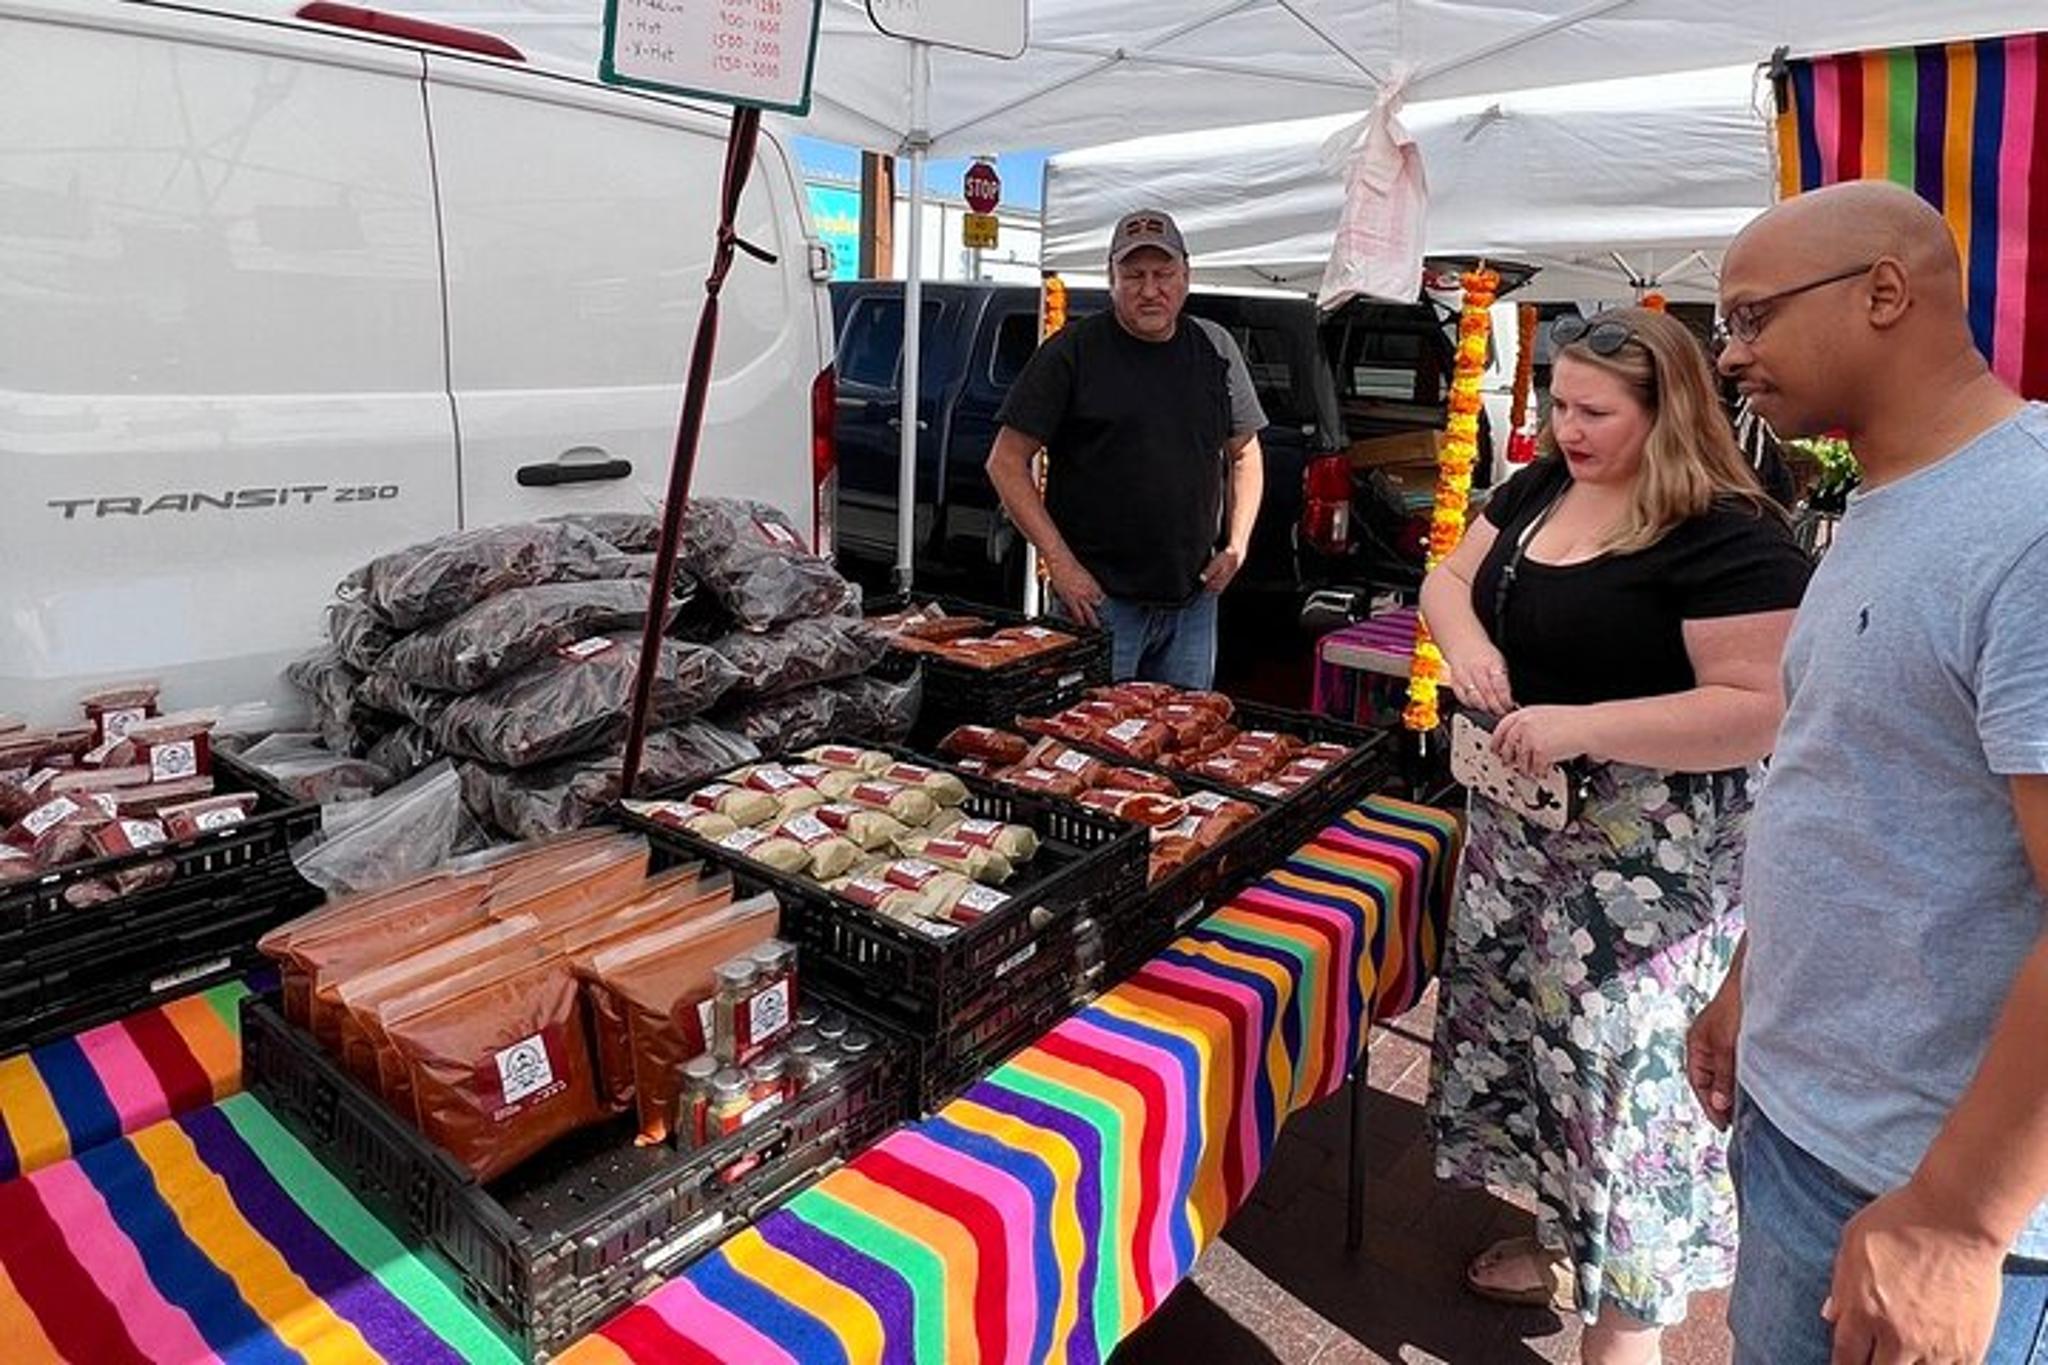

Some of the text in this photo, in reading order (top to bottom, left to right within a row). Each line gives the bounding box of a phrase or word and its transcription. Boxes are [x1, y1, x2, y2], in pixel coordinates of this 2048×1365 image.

[967, 178, 997, 199] STOP
[46, 485, 399, 518] TRANSIT 250
